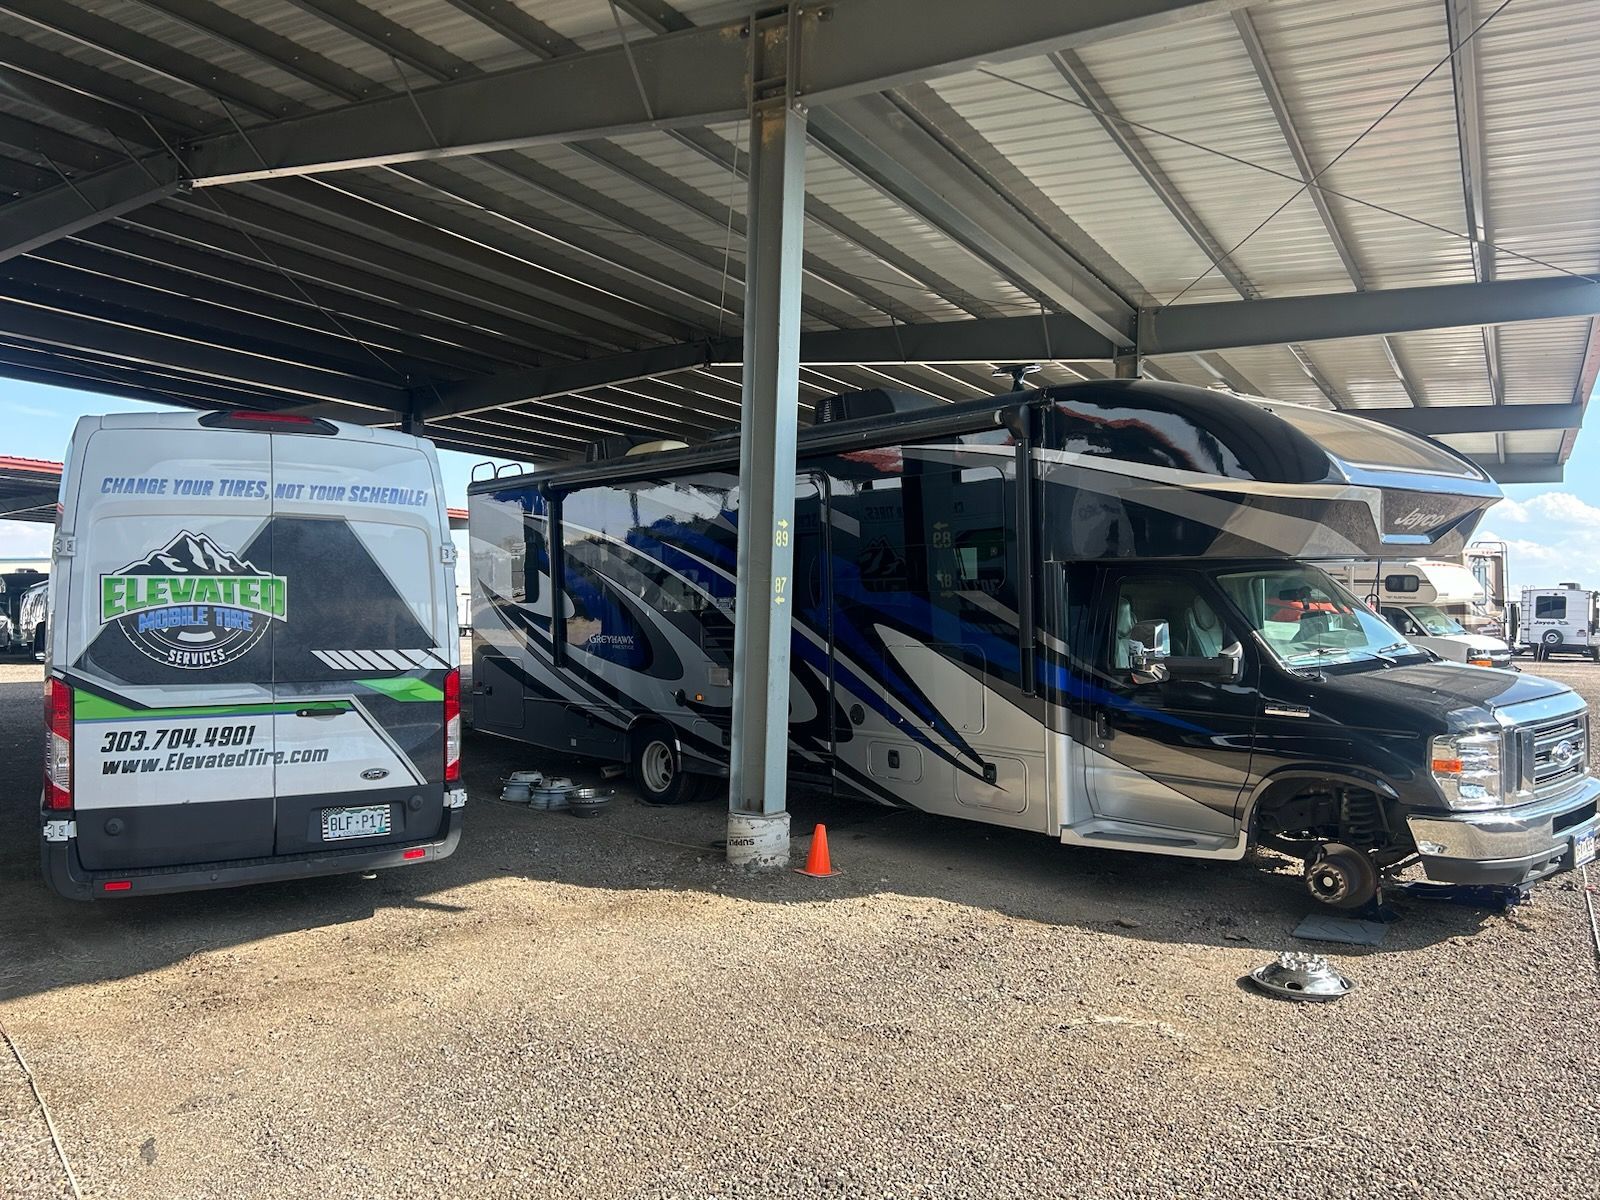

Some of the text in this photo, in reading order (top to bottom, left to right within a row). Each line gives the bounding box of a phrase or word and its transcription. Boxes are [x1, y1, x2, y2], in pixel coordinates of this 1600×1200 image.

[101, 477, 428, 507] CHANGE YOUR TIRES, NOT YOUR SCHEDULE!
[1394, 508, 1445, 530] Jayco
[776, 530, 788, 547] 89
[775, 576, 787, 594] 87
[103, 578, 286, 619] ELEVATED
[138, 606, 253, 633] MOBILE TIRE
[590, 634, 634, 645] GREYHAWK
[168, 649, 226, 665] SERVICES
[100, 725, 256, 753] 303.704.4901
[102, 748, 329, 775] www.ElevatedTire.com
